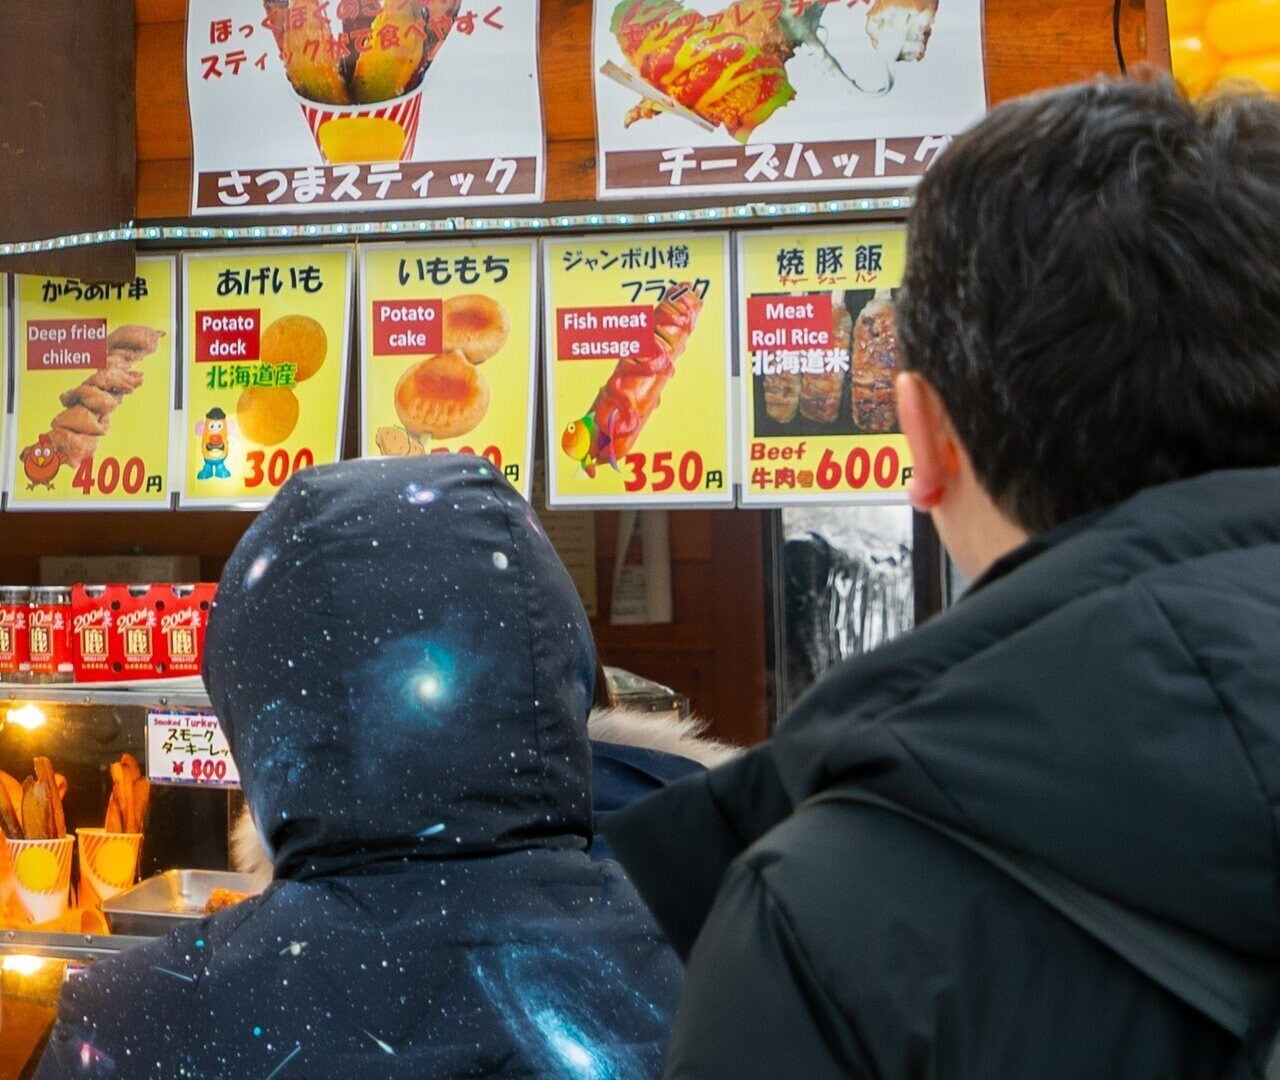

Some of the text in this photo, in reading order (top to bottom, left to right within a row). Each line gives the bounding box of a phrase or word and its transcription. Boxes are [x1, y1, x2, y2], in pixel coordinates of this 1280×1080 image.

[217, 158, 517, 206] さつまスティック
[563, 245, 690, 271] ジャンボ小樽
[777, 244, 882, 275] 焼豚飯
[398, 255, 509, 286] いももち
[216, 266, 324, 296] あげいも
[621, 277, 710, 303] フランク
[380, 306, 435, 322] Potato
[563, 312, 647, 330] Fish meat
[765, 303, 814, 319] Meat
[28, 323, 106, 343] Deep fried
[202, 316, 254, 333] Potato
[389, 331, 427, 347] cake
[751, 327, 829, 346] Roll Rice
[42, 349, 91, 364] chiken
[209, 339, 246, 356] dock
[571, 339, 640, 357] sausage
[751, 349, 850, 375] 北海道米
[206, 363, 297, 389] 北海道産
[749, 441, 806, 462] Beef
[72, 456, 162, 495] 400円
[624, 450, 723, 492] 350円
[168, 728, 214, 742] スモーク
